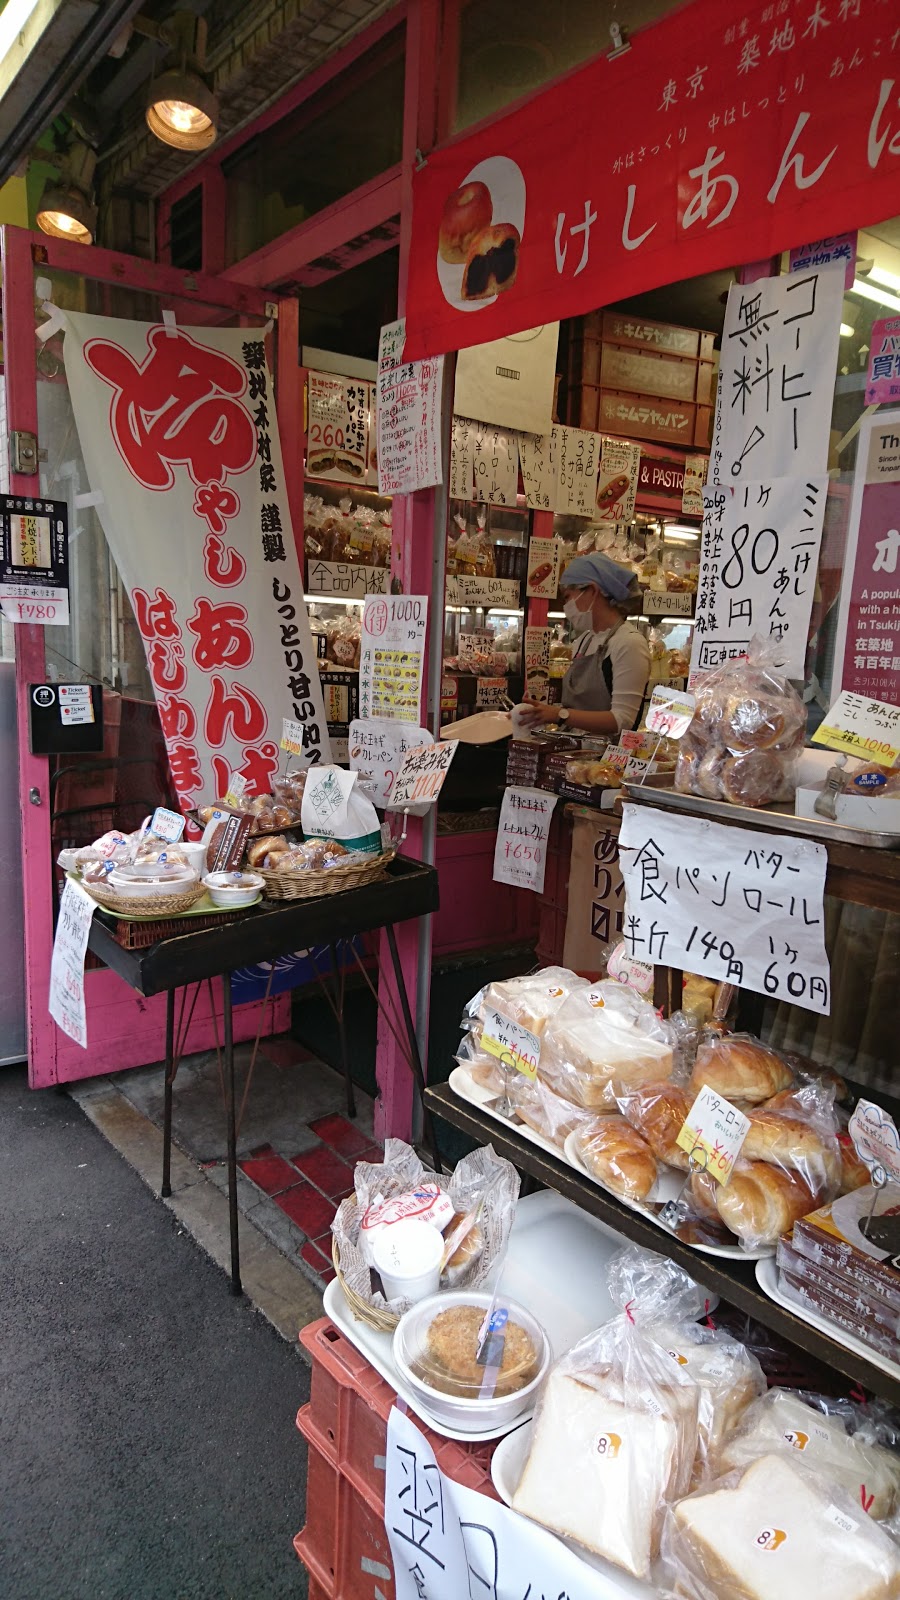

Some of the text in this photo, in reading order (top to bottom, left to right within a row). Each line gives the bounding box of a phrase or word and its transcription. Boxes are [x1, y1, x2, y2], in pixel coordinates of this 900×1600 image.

[657, 65, 709, 112] 東京
[611, 127, 688, 174] 外はさっくり
[707, 73, 805, 135] 中はしっとり
[781, 273, 820, 450] コーヒー
[241, 341, 278, 493] 築地木村家
[345, 386, 357, 451] カレーパン
[616, 403, 690, 429] キムラヤのパン
[879, 434, 900, 450] Th
[490, 430, 501, 493] ターロール
[878, 455, 898, 464] Since
[640, 466, 650, 484] &
[652, 467, 685, 489] PASTR
[308, 561, 388, 596] 全品内税
[720, 523, 780, 628] 80 円
[5, 586, 56, 598] ご注文承ります
[646, 596, 682, 611] バターロール
[860, 588, 869, 600] A
[16, 602, 57, 620] ¥780
[368, 605, 386, 633] 得
[859, 604, 881, 615] with
[882, 606, 890, 615] a
[857, 619, 900, 631] in Tsukij
[363, 650, 371, 662] 月
[854, 637, 894, 652] 在築地
[363, 664, 370, 675] 火
[361, 679, 370, 689] 水
[361, 692, 369, 704] 木
[842, 694, 863, 710] ミニ
[361, 704, 370, 718] 金
[361, 749, 394, 763] カレーパン
[863, 737, 896, 759] 1010円
[504, 840, 542, 864] ¥650
[743, 849, 801, 879] バター
[632, 837, 732, 907] 食パン
[742, 887, 820, 926] ロール
[623, 914, 745, 985] 半斤 140円
[763, 961, 829, 1007] 60円
[491, 1012, 527, 1040] 食パン
[508, 1040, 537, 1073] ¥140
[699, 1092, 746, 1136] バターロール
[709, 1138, 735, 1175] ¥60
